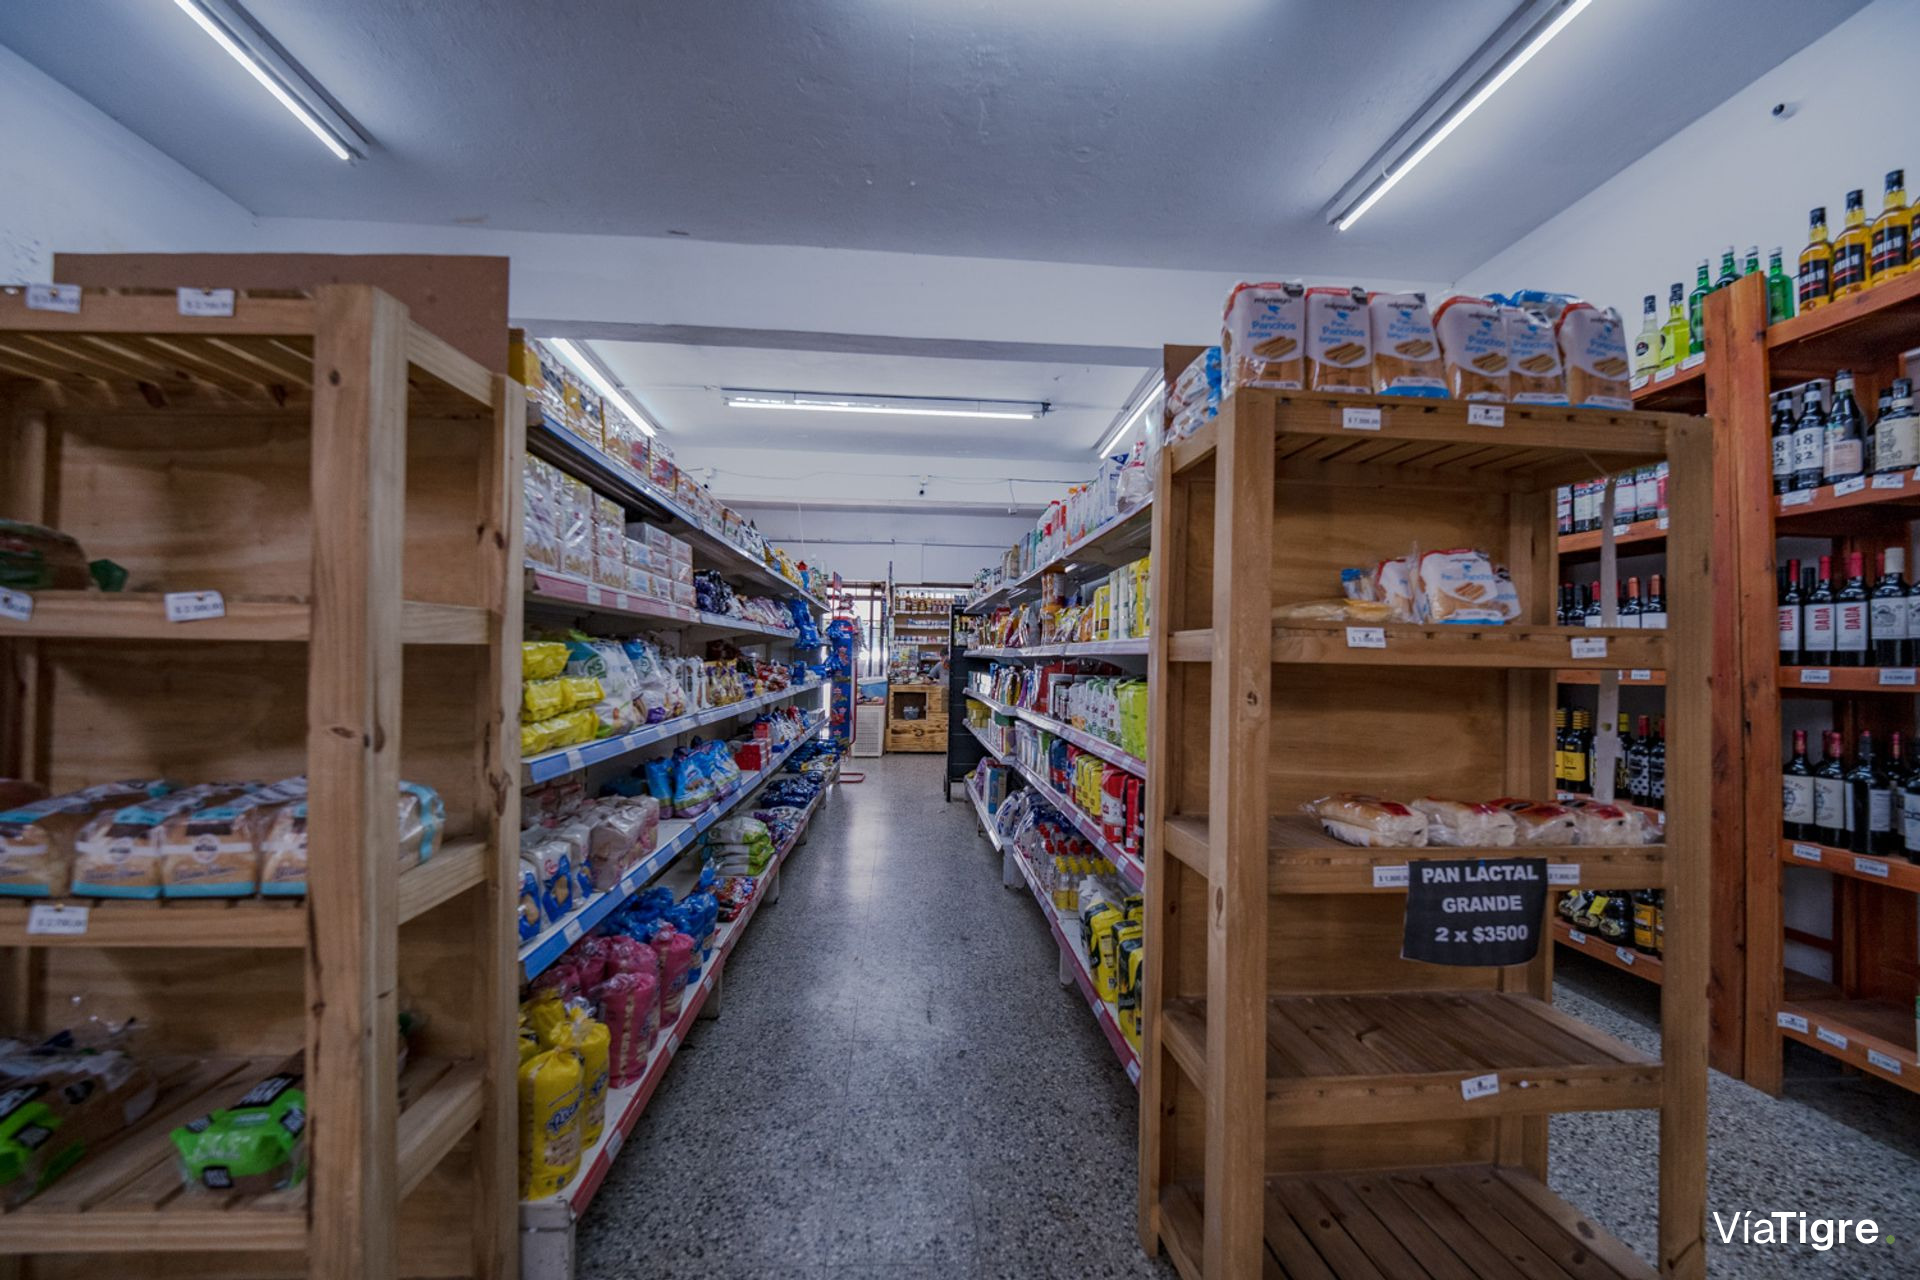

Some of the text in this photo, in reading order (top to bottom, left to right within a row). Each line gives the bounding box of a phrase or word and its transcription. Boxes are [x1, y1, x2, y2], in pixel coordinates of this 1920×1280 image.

[1251, 320, 1297, 330] Panchos
[1322, 325, 1365, 337] Panchos
[1844, 606, 1861, 630] DADA
[1421, 865, 1539, 884] PAN LACTAL
[1442, 895, 1523, 913] GRANDE
[1434, 925, 1529, 944] 2 x $3500
